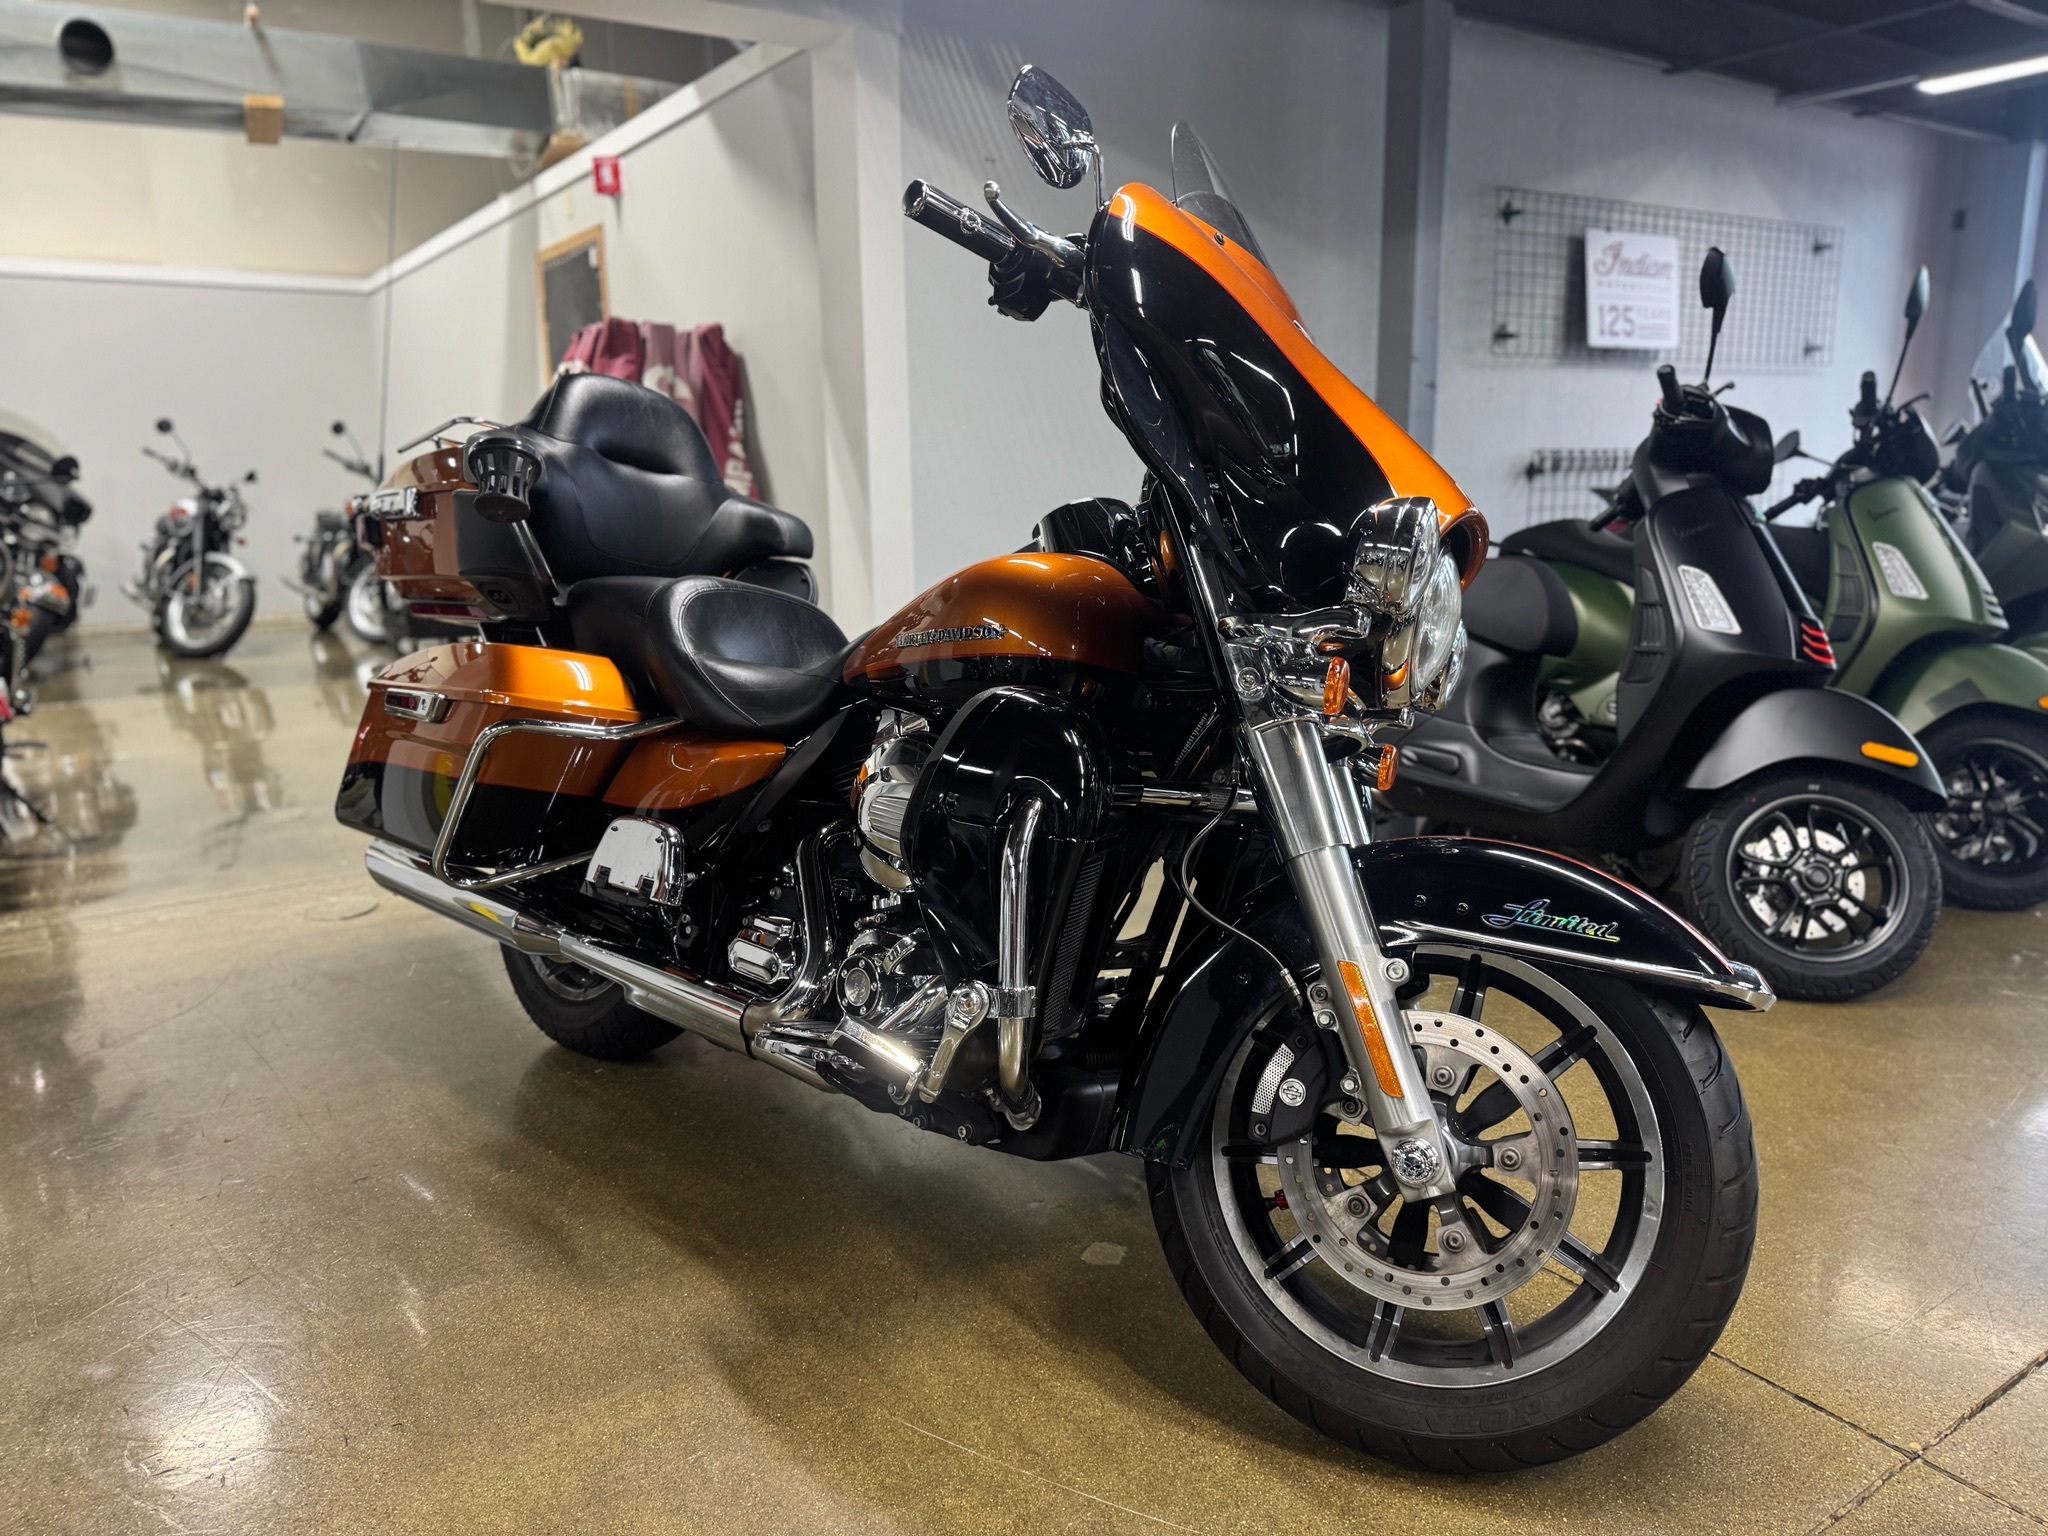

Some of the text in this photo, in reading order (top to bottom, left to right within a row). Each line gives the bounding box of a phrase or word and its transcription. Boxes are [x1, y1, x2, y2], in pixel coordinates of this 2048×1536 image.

[1593, 240, 1672, 278] Indian
[1598, 304, 1634, 337] 125
[1481, 899, 1620, 942] Limited
